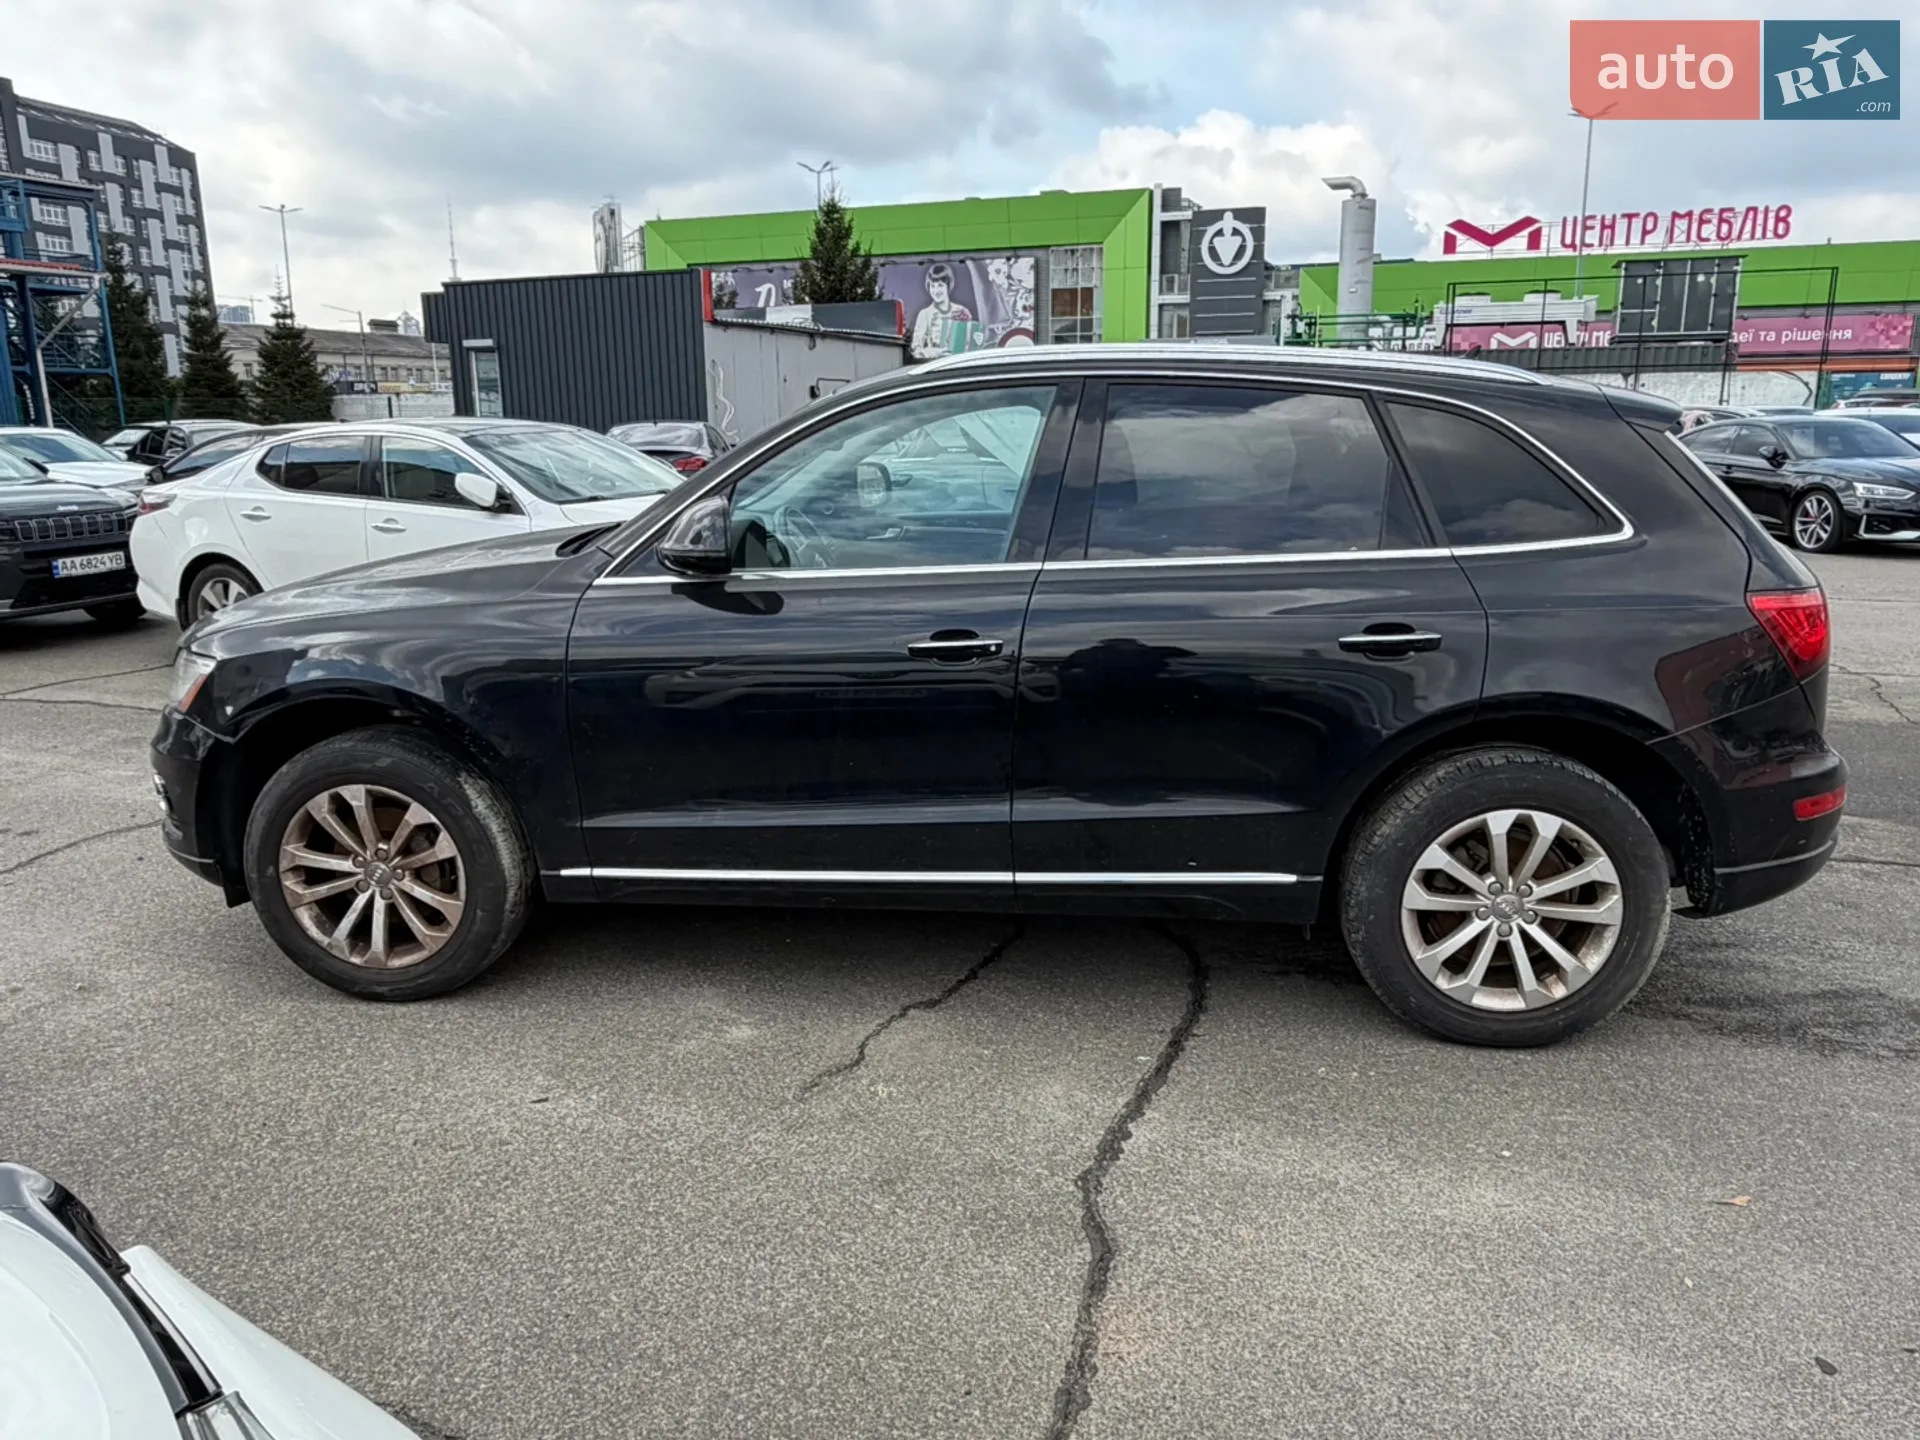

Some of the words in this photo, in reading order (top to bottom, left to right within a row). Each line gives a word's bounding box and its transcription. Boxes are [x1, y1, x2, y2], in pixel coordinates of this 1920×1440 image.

[1560, 212, 1659, 251] ЦЕНТР
[1669, 204, 1793, 243] МЕБЛІВ
[1758, 330, 1777, 342] та
[1781, 327, 1853, 345] рішення
[61, 561, 78, 573] AA
[79, 556, 106, 571] 6824
